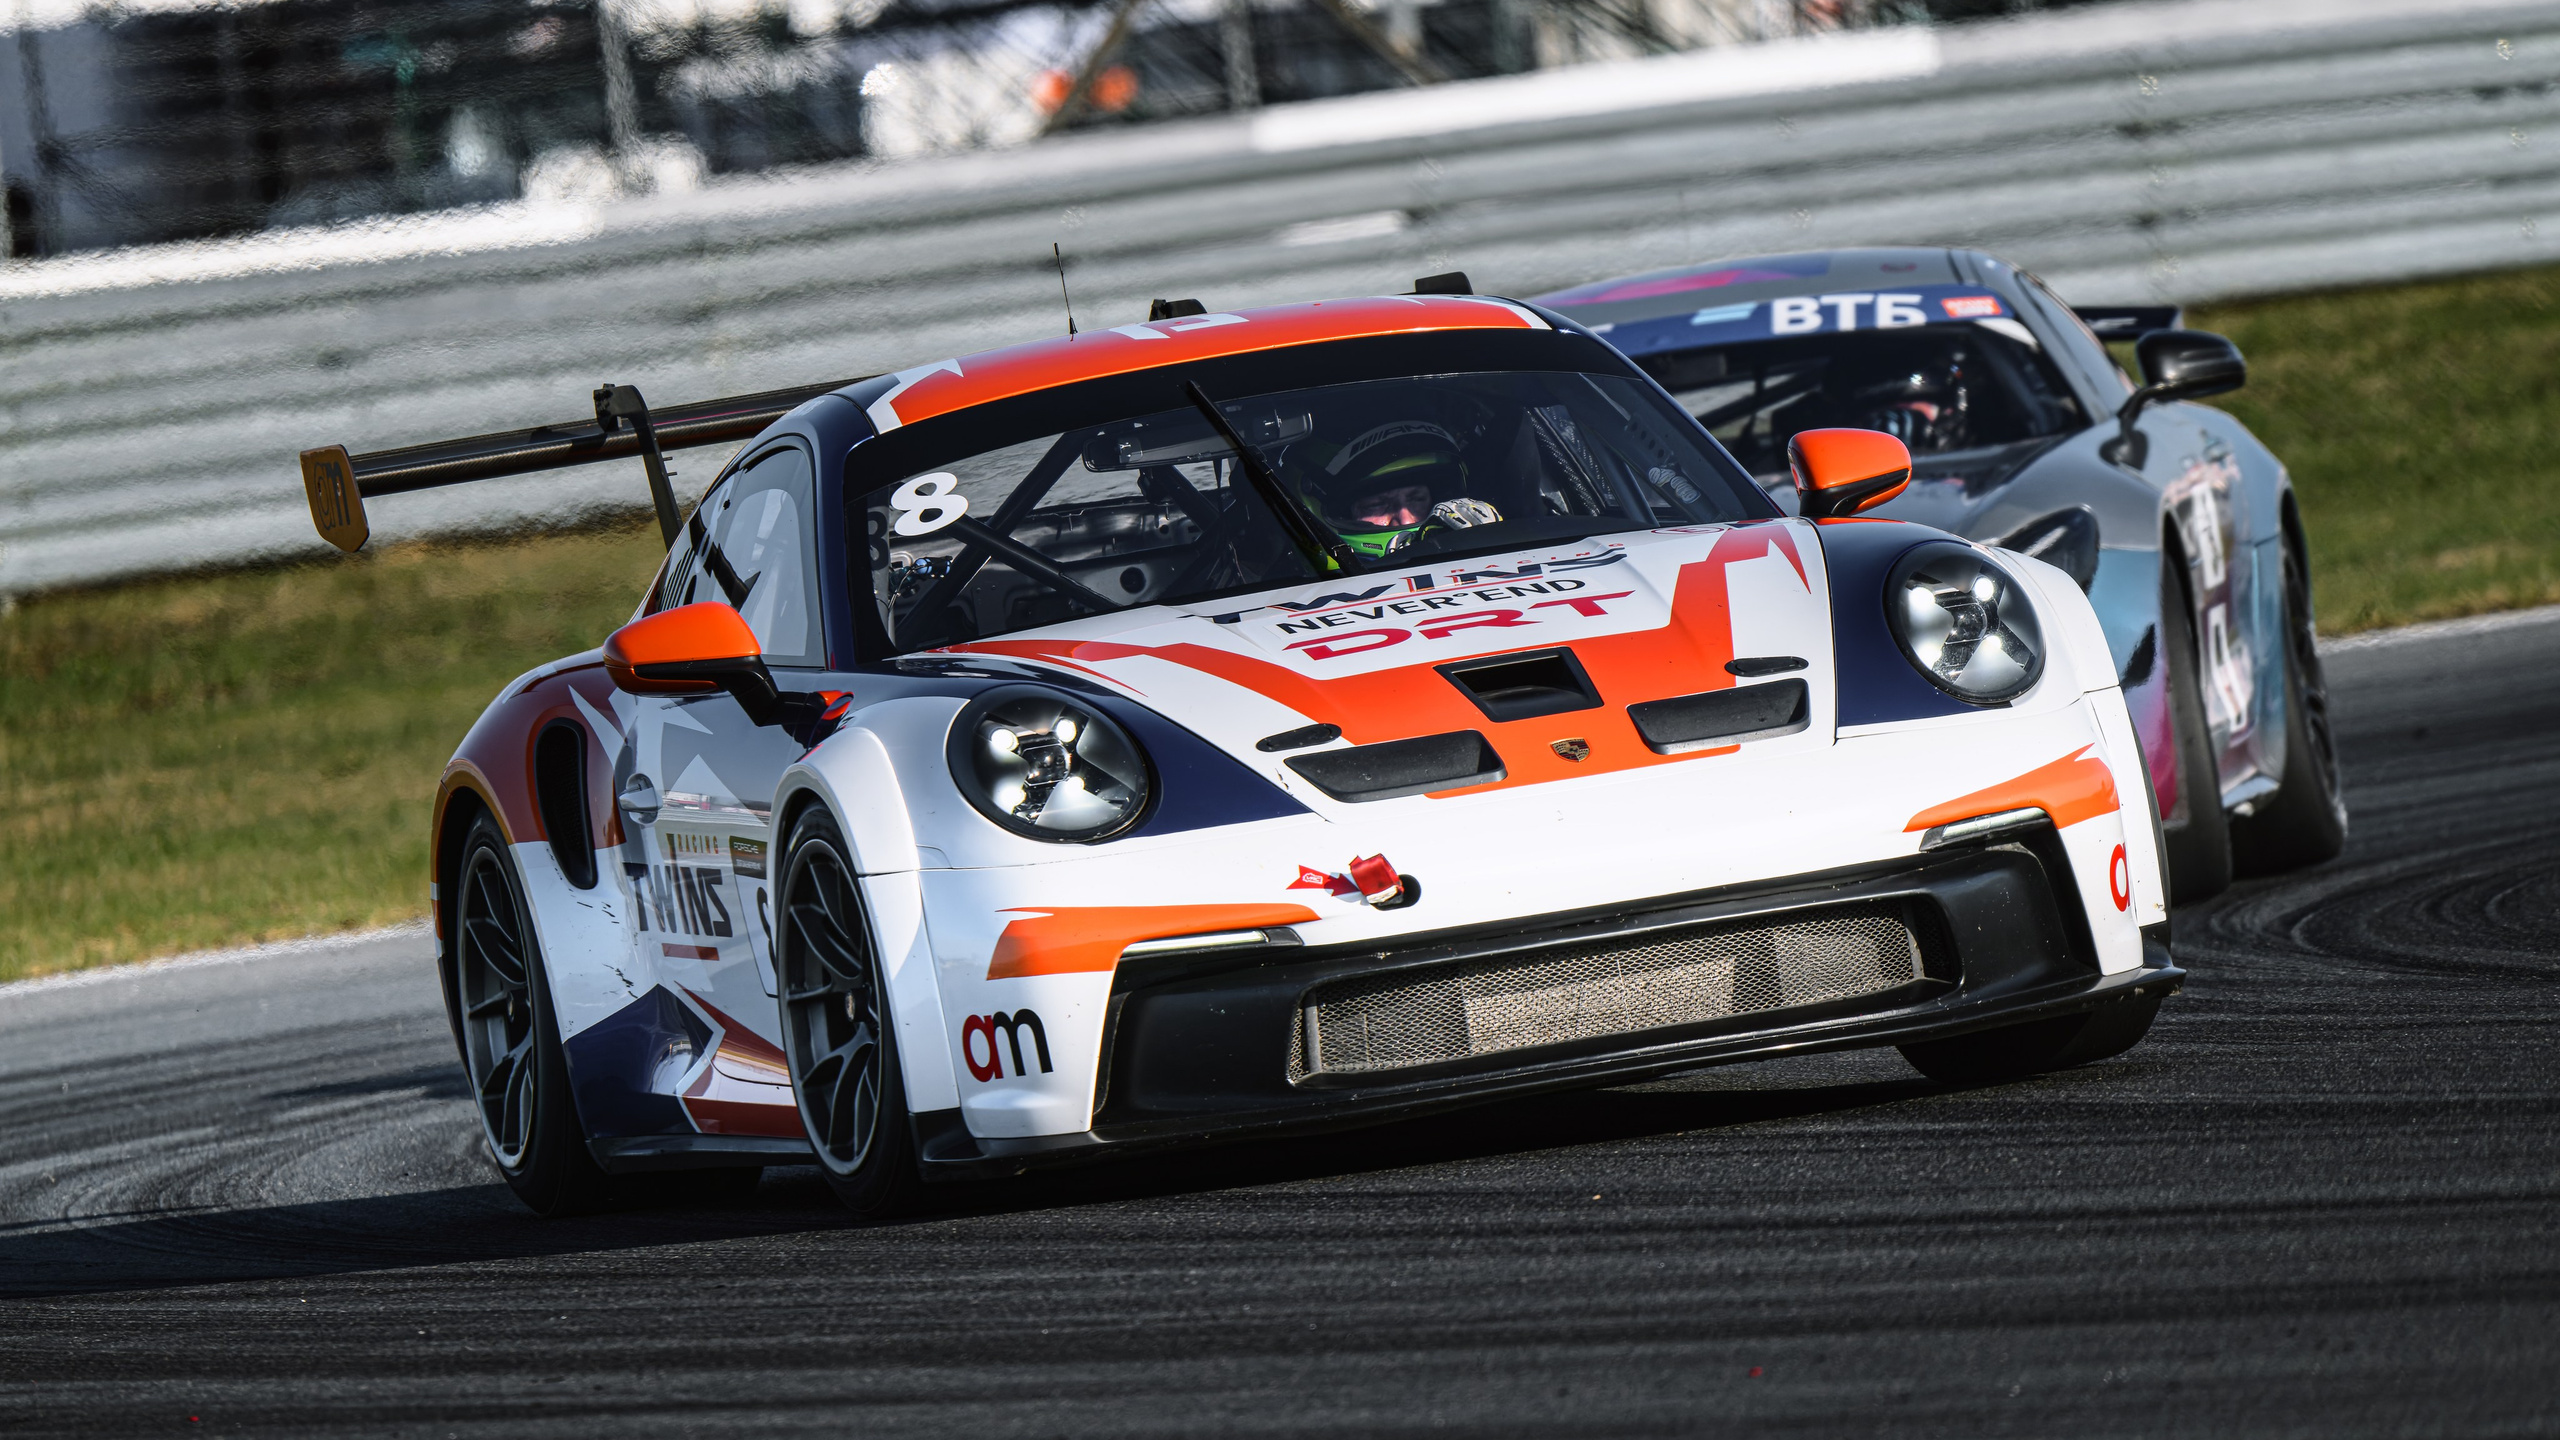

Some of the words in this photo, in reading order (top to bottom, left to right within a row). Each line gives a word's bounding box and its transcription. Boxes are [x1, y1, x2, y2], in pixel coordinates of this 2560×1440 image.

[1772, 293, 1927, 335] ВТБ
[891, 472, 968, 536] 8
[1176, 548, 1627, 624] TWINS
[1282, 590, 1636, 661] DRT
[677, 833, 719, 854] RACING
[733, 842, 759, 854] PORSCHE
[623, 833, 733, 937] TWINS
[962, 1009, 1054, 1083] am
